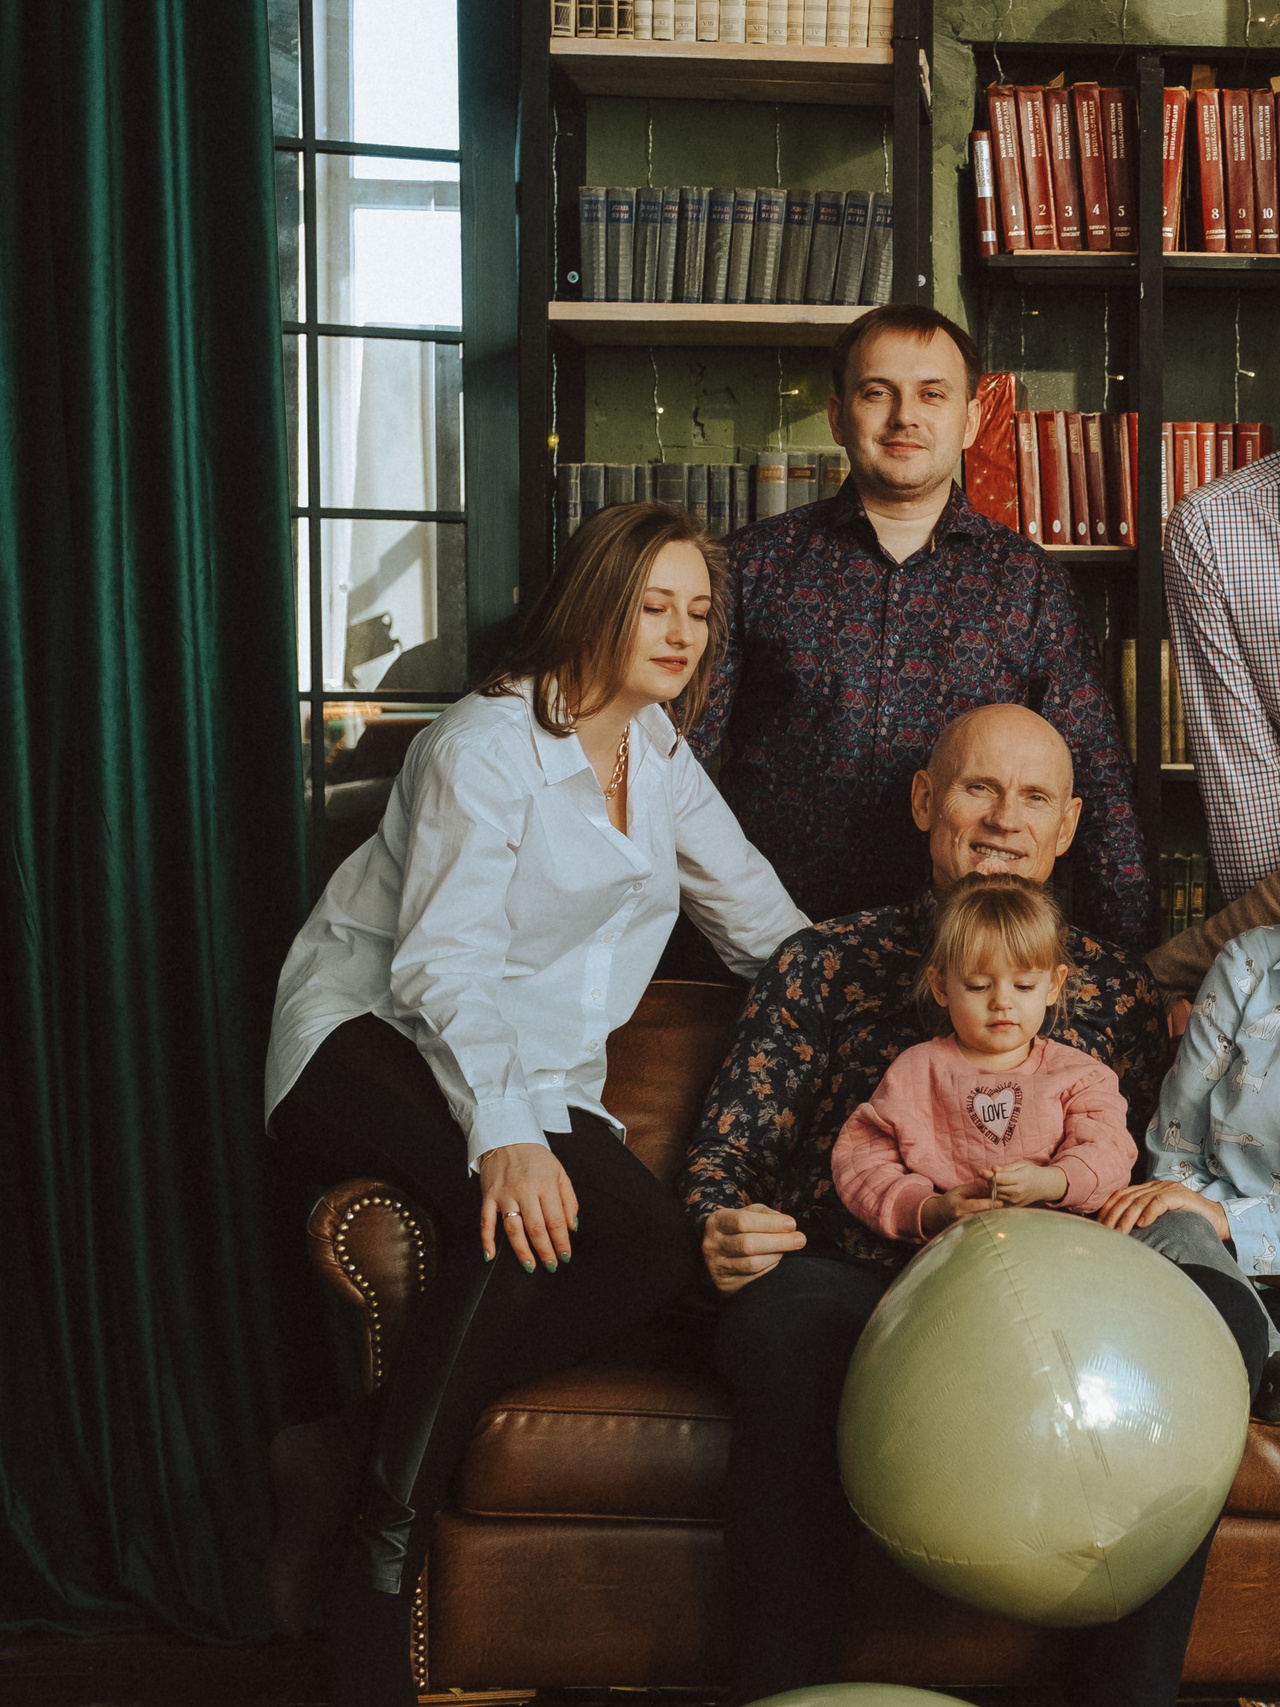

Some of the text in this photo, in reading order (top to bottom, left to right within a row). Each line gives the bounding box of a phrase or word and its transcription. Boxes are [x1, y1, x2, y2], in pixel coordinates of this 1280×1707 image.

[1011, 205, 1016, 216] 1
[1039, 204, 1046, 215] 2
[1065, 206, 1072, 217] 3
[1093, 204, 1100, 215] 4
[1118, 206, 1125, 216] 5
[1212, 208, 1219, 219] 8
[1239, 208, 1246, 218] 9
[1263, 208, 1273, 218] 10
[982, 1102, 1009, 1122] LOVE
